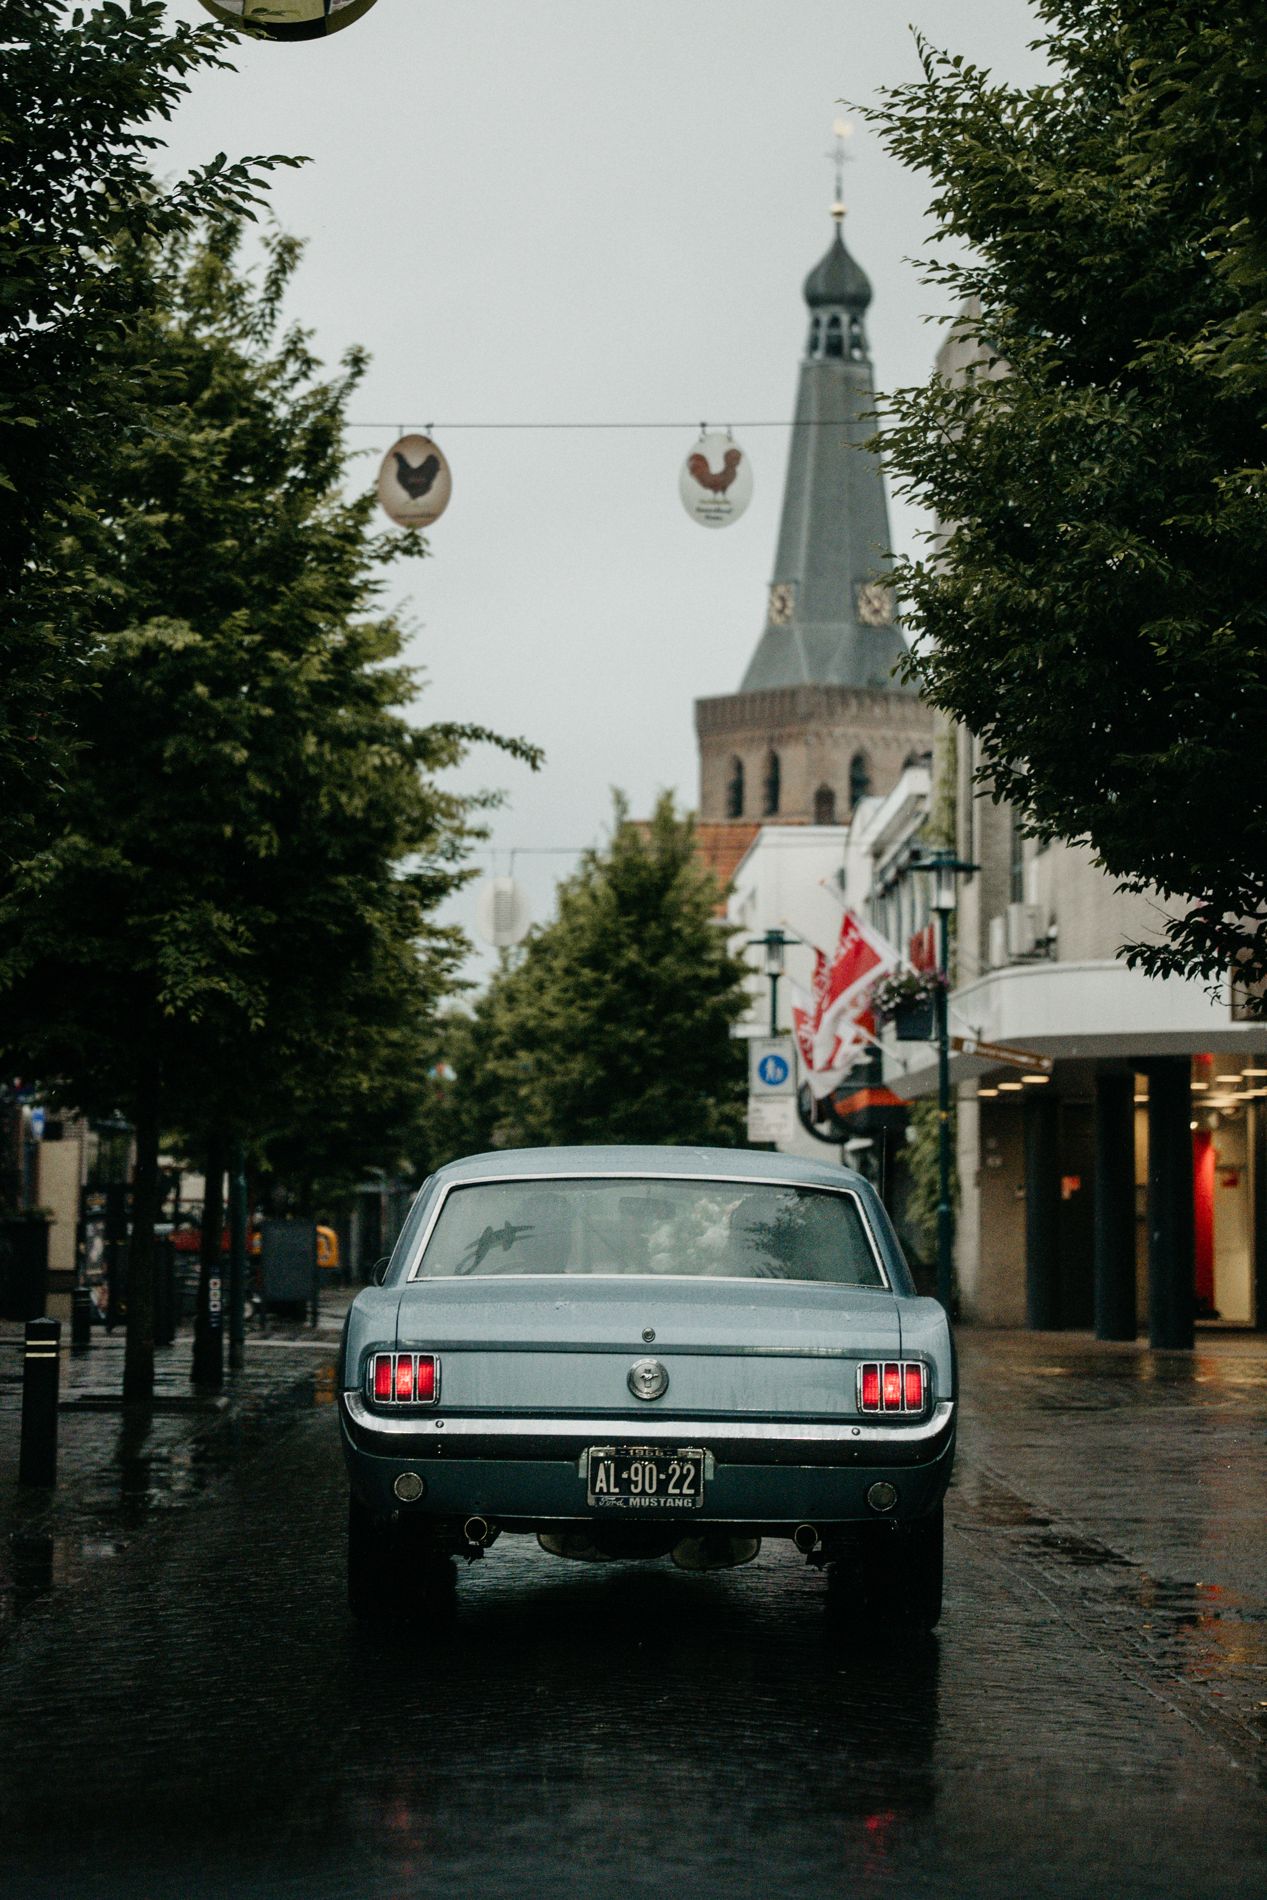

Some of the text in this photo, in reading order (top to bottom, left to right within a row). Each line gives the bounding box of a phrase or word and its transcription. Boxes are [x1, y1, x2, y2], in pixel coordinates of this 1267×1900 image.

[595, 1462, 696, 1494] AL-90-22
[598, 1496, 693, 1508] Ford MUSTANG
